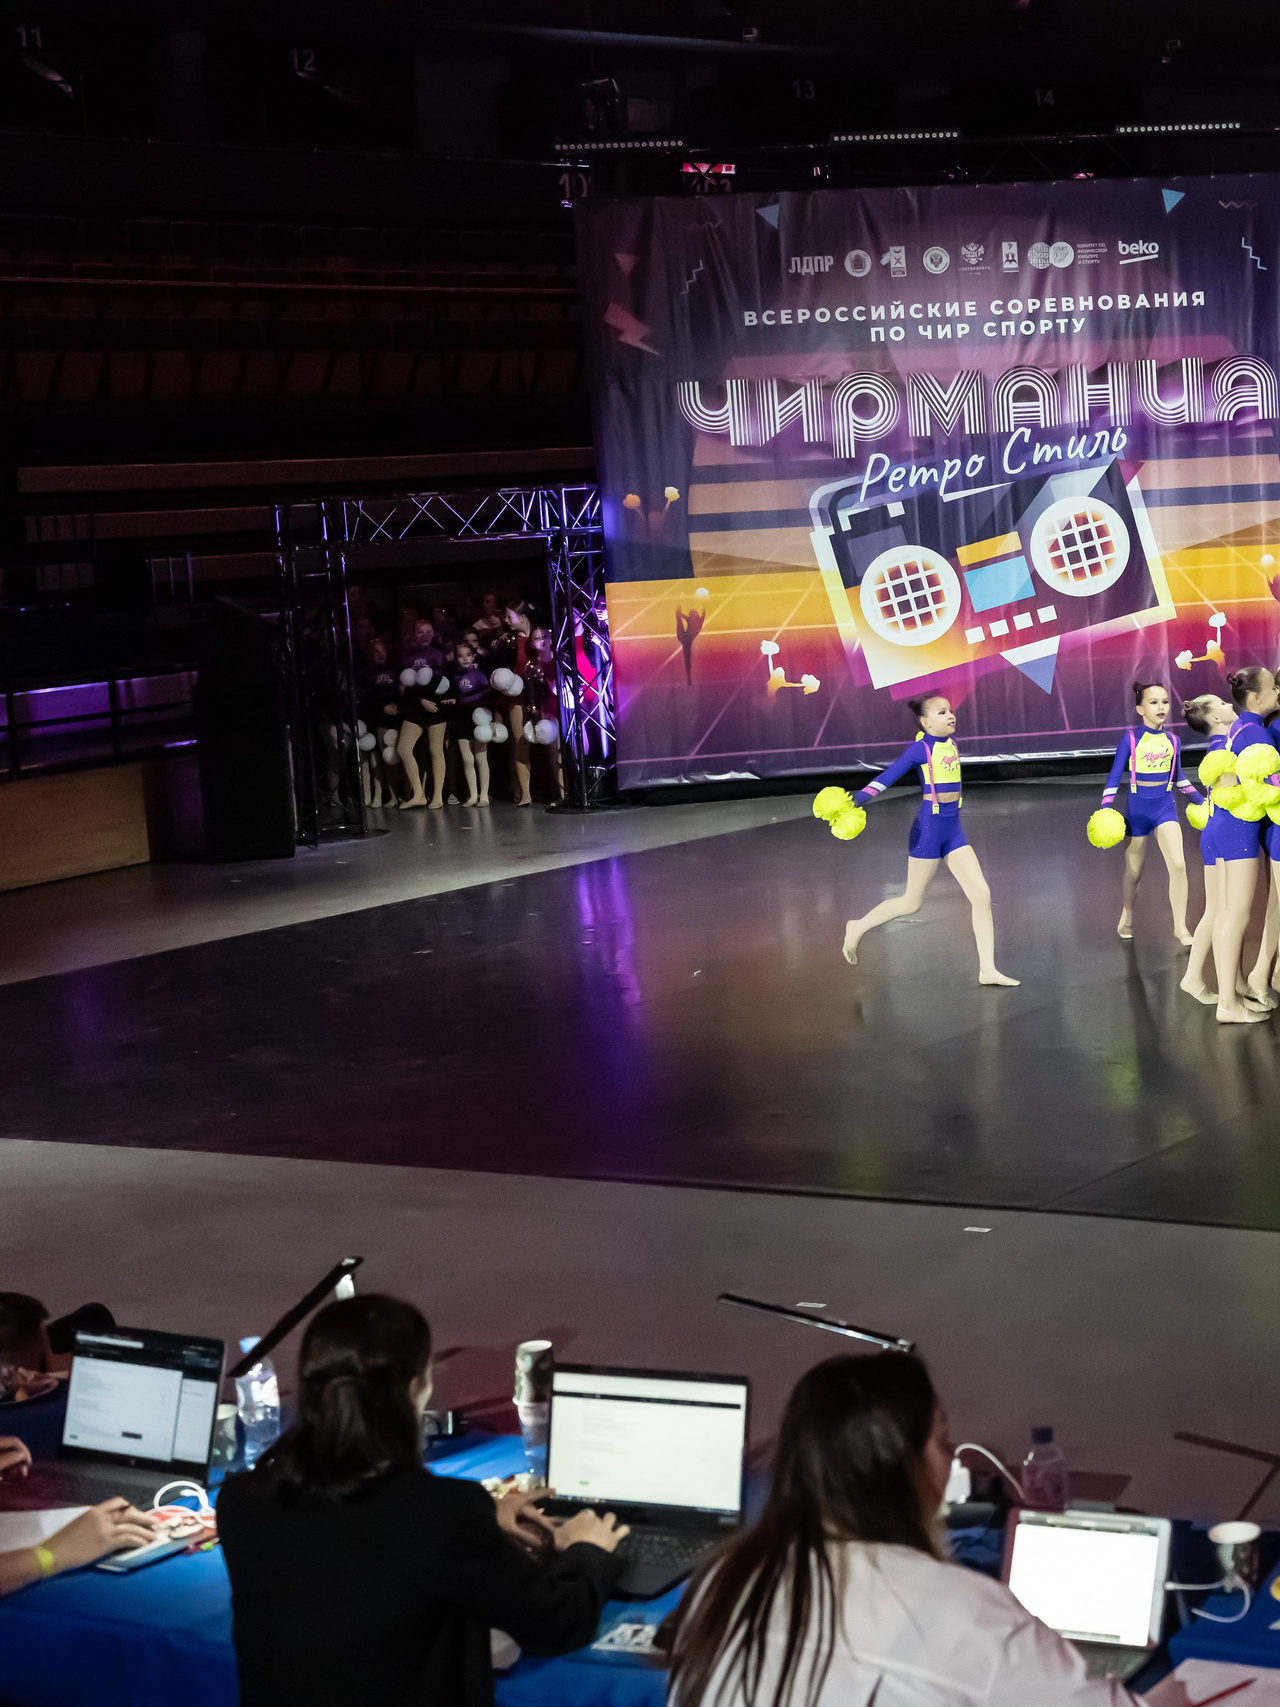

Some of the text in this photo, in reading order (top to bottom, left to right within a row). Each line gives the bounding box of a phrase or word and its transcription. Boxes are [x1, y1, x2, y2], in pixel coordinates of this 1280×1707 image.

[1118, 240, 1160, 255] beko
[789, 255, 835, 275] ЛДПР
[743, 291, 1205, 326] ВСЕРОССИЙСКИЕ СОРЕВНОВАНИЯ
[870, 317, 1086, 342] ПО ЧИР СПОРТУ
[859, 426, 1128, 502] Ретро Стиль
